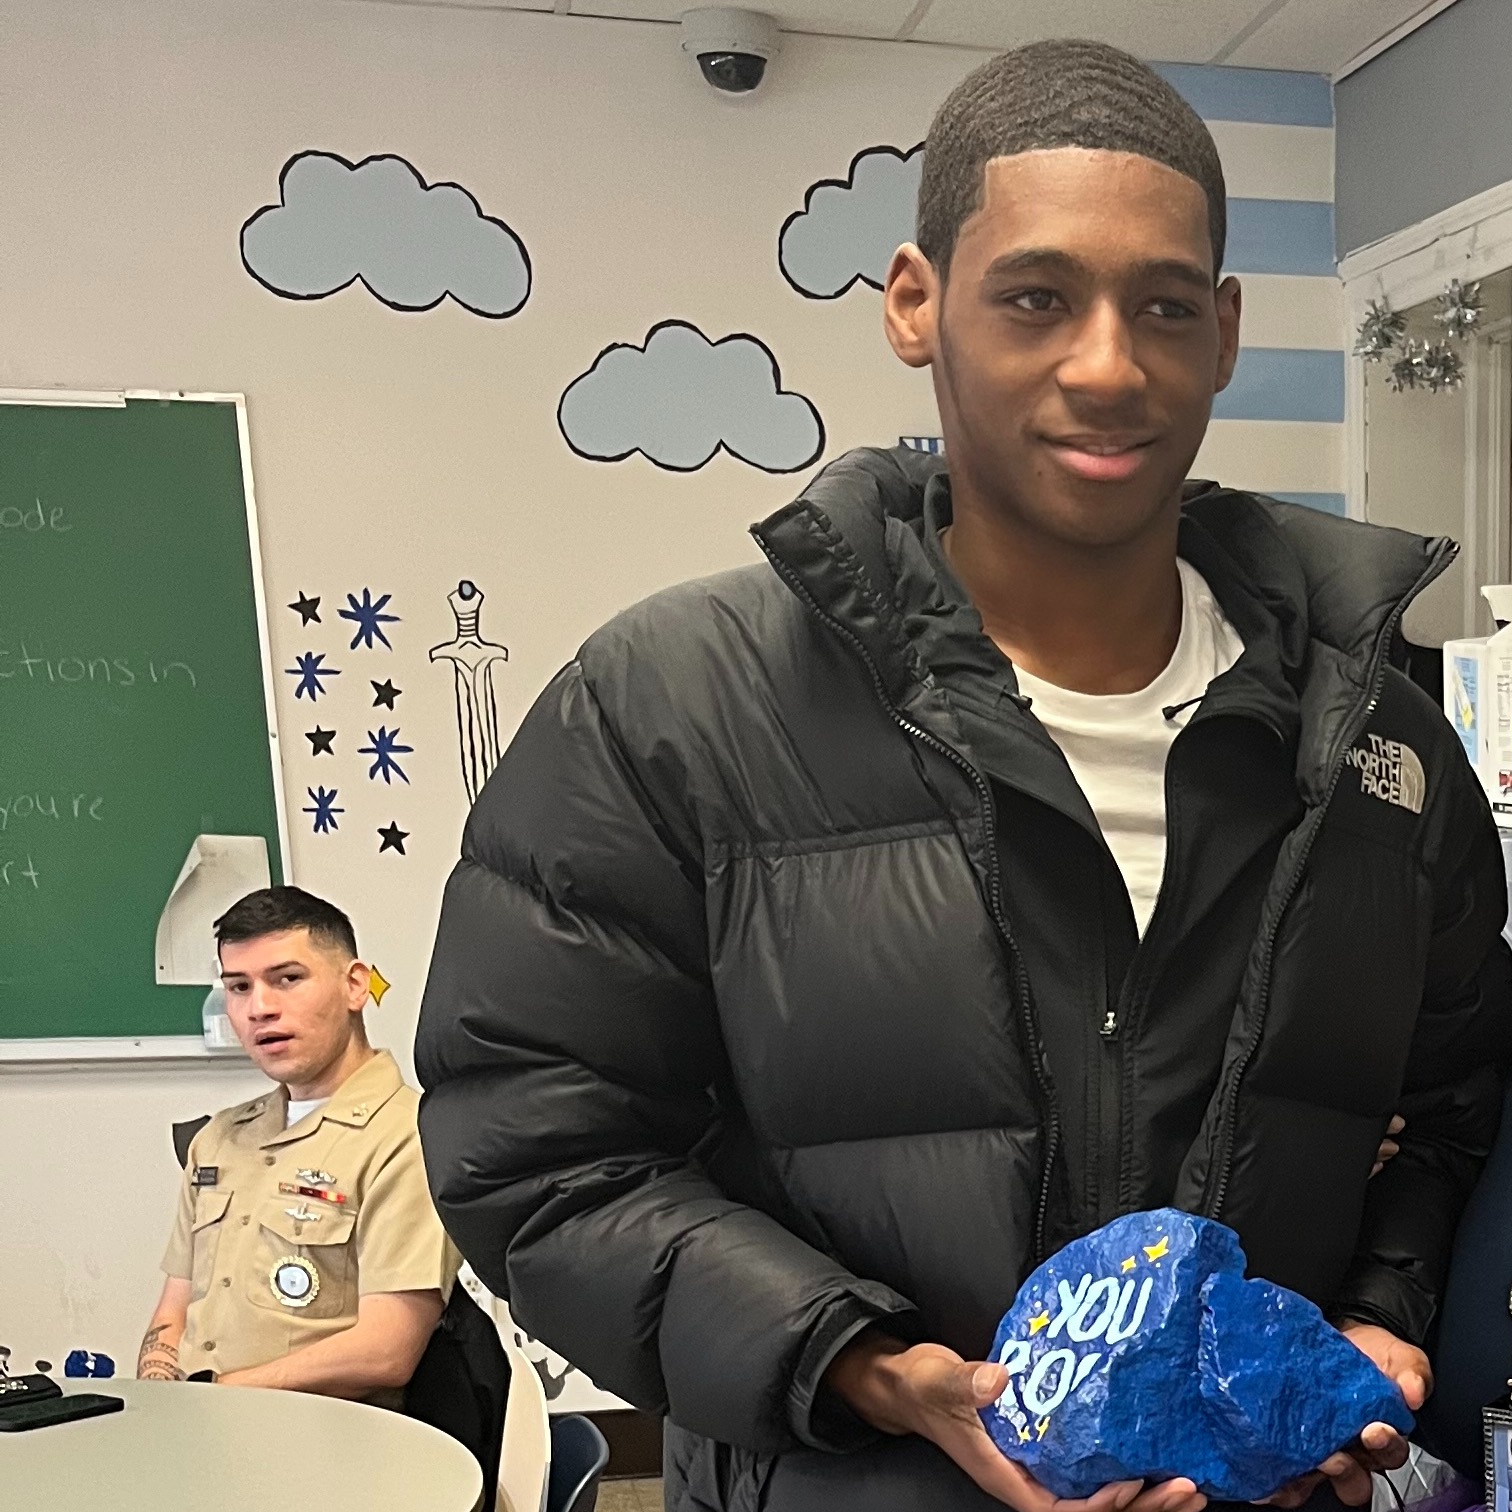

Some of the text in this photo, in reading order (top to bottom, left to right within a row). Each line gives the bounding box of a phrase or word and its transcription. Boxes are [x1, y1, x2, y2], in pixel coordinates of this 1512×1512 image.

[1345, 746, 1401, 783] NORTH
[1367, 733, 1401, 762] THE
[1360, 771, 1401, 806] FACE
[1047, 1273, 1153, 1345] YOU
